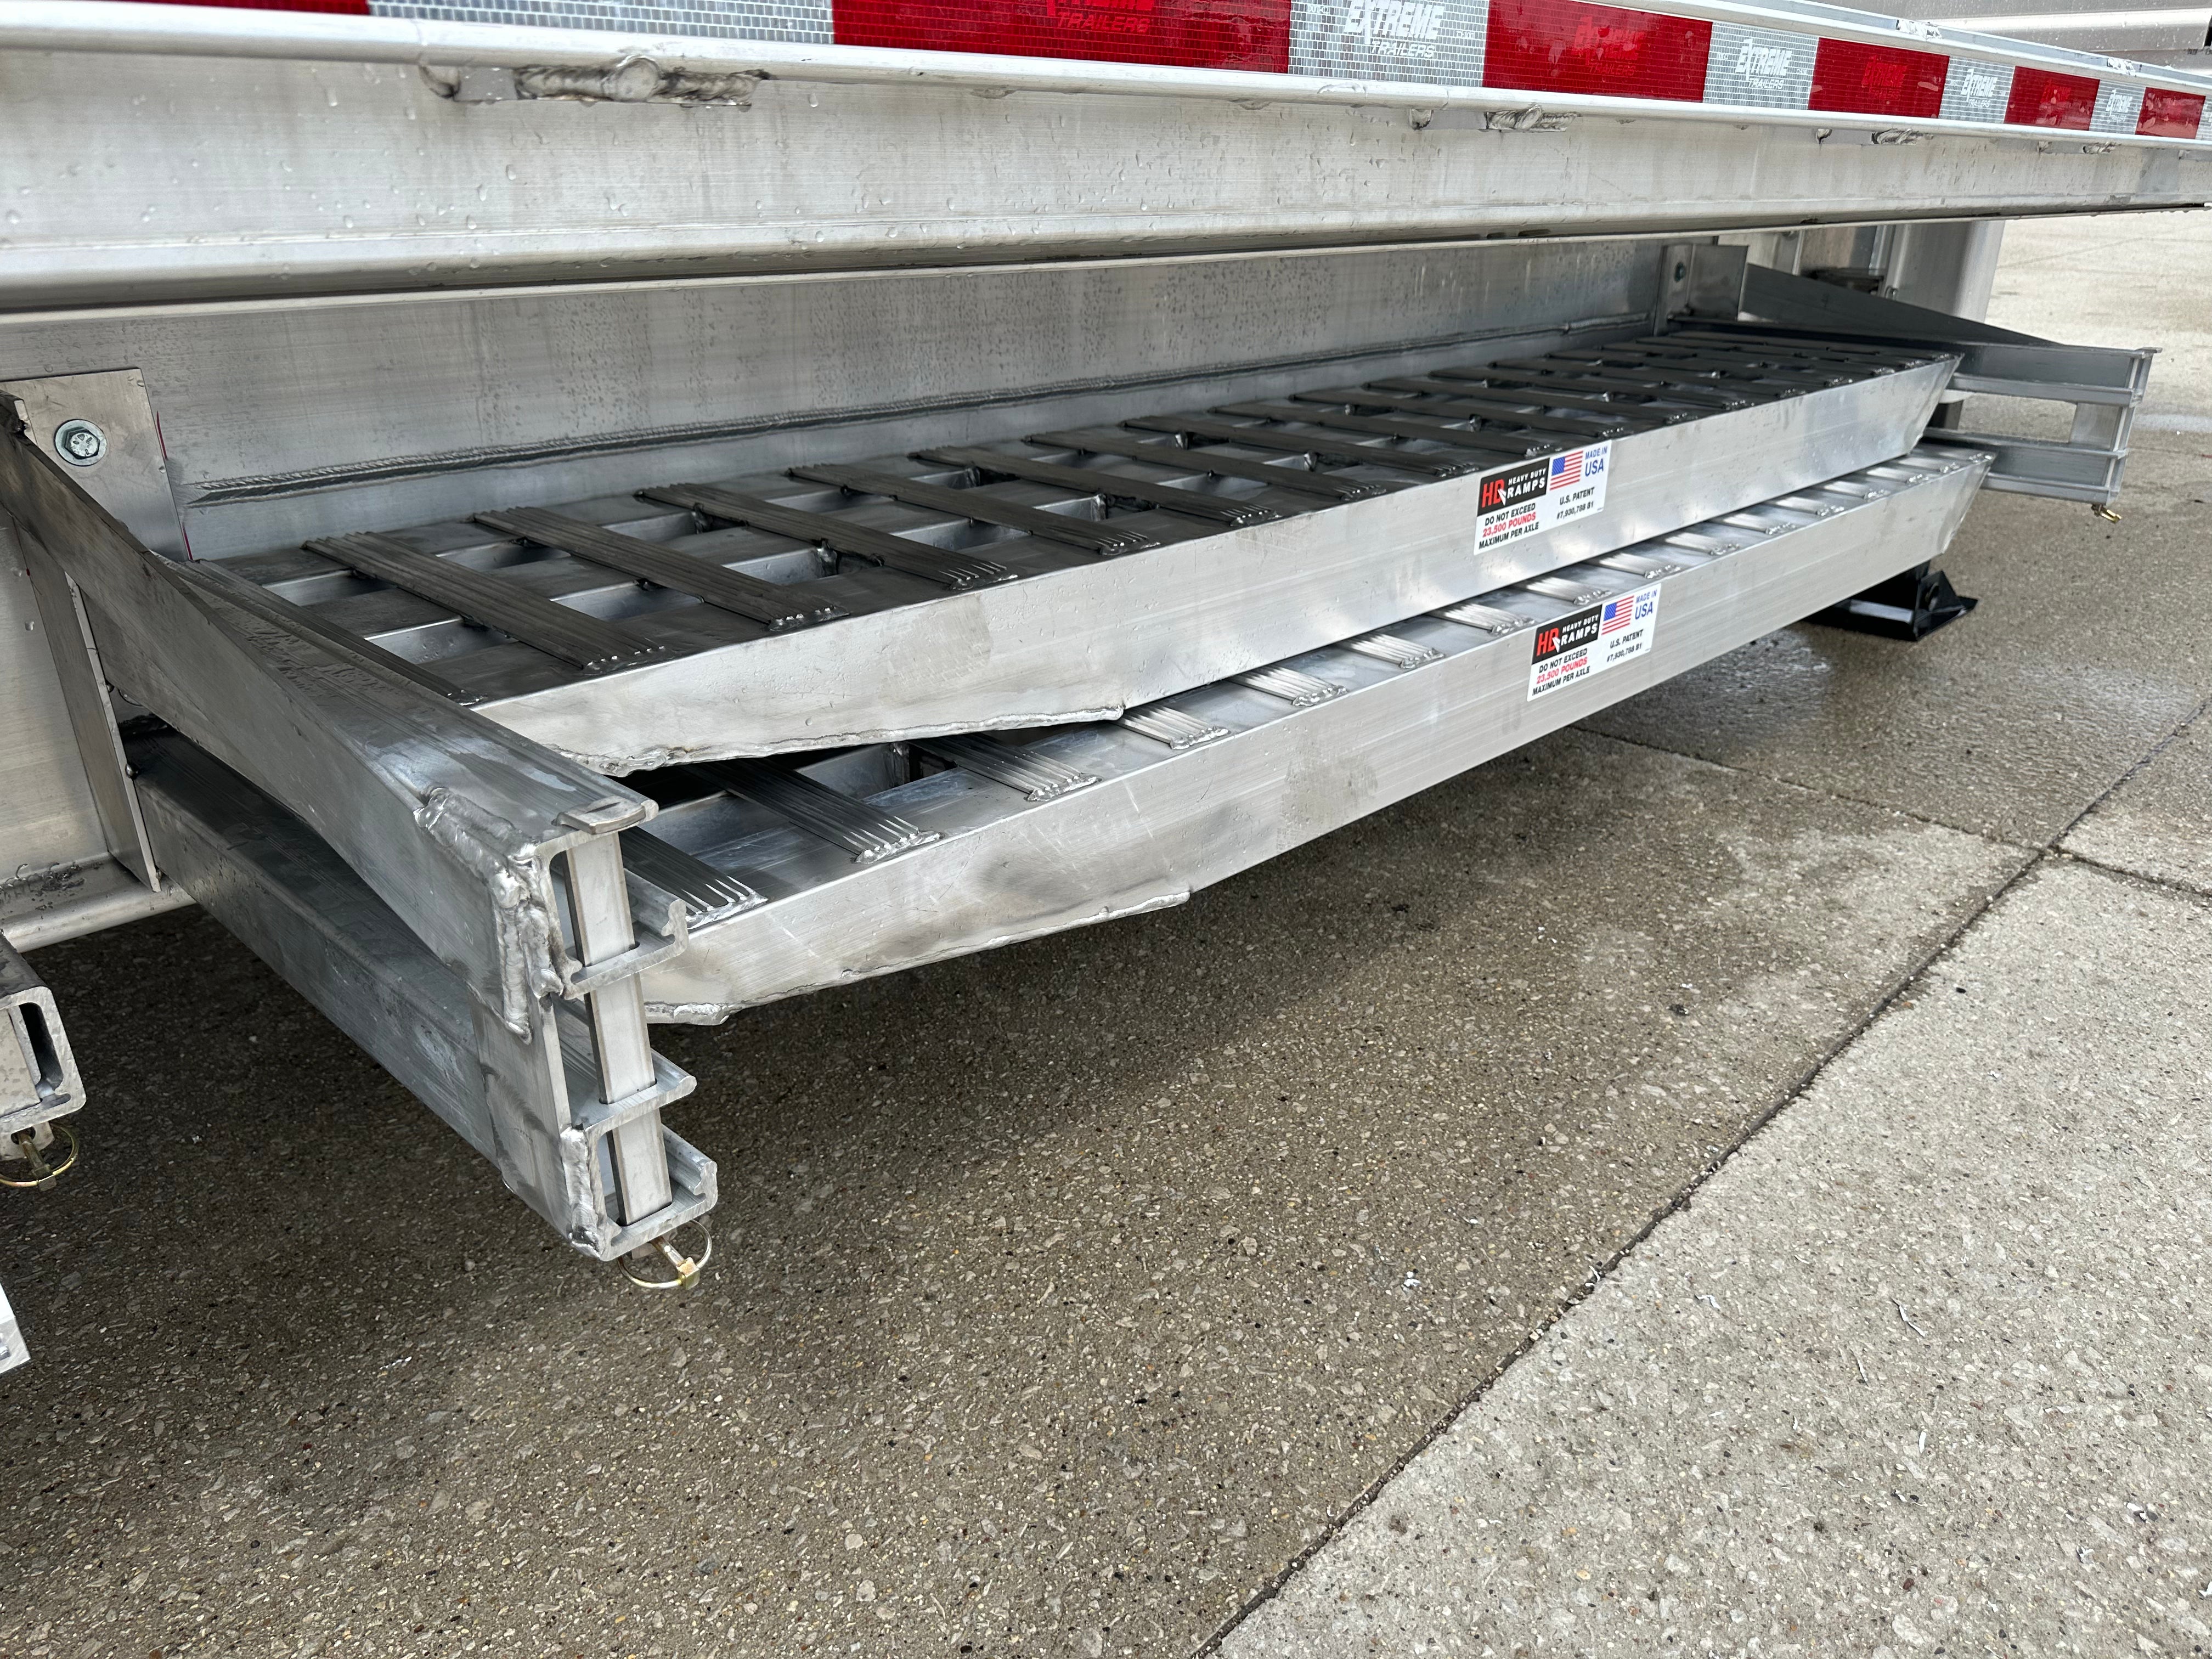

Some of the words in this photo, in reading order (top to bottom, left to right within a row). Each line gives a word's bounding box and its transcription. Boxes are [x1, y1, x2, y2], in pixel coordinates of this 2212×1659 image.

[1058, 12, 1150, 33] TRAILERS
[1344, 0, 1444, 44] EXTREME
[1372, 41, 1435, 58] TRAILERS
[1735, 38, 1792, 81] EXTREME
[1748, 78, 1784, 89] TRAILERS
[1960, 69, 1997, 101] EXTREME
[1585, 448, 1600, 460] MADE
[1601, 447, 1607, 455] IN
[1508, 473, 1528, 486] HEAVY
[1530, 467, 1546, 479] DUTY
[1585, 458, 1604, 477] USA
[1481, 478, 1505, 508] HD
[1507, 477, 1545, 499] RAMPS
[1559, 495, 1571, 505] U.S.
[1572, 487, 1595, 501] PATENT
[1482, 522, 1506, 538] 23,500
[1508, 512, 1536, 529] POUNDS
[1485, 516, 1494, 526] DO
[1496, 511, 1510, 522] NOT
[1511, 503, 1536, 517] EXCEED
[1479, 532, 1509, 549] MAXIMUM
[1510, 528, 1522, 538] PER
[1523, 522, 1539, 533] AXLE
[1635, 592, 1650, 603] MADE
[1651, 589, 1657, 597] IN
[1635, 601, 1653, 620] USA
[1561, 623, 1598, 646] RAMPS
[1562, 620, 1582, 633] HEAVY
[1583, 614, 1599, 625] DUTY
[1536, 628, 1559, 656] HD
[1610, 639, 1620, 648] U.S.
[1622, 629, 1644, 644] PATENT
[1536, 668, 1559, 684] 23,500
[1561, 657, 1588, 675] POUNDS
[1539, 663, 1548, 673] DO
[1550, 657, 1562, 669] NOT
[1564, 648, 1588, 663] EXCEED
[1532, 678, 1561, 696] MAXIMUM
[1563, 672, 1574, 684] PER
[1575, 665, 1590, 679] AXLE
